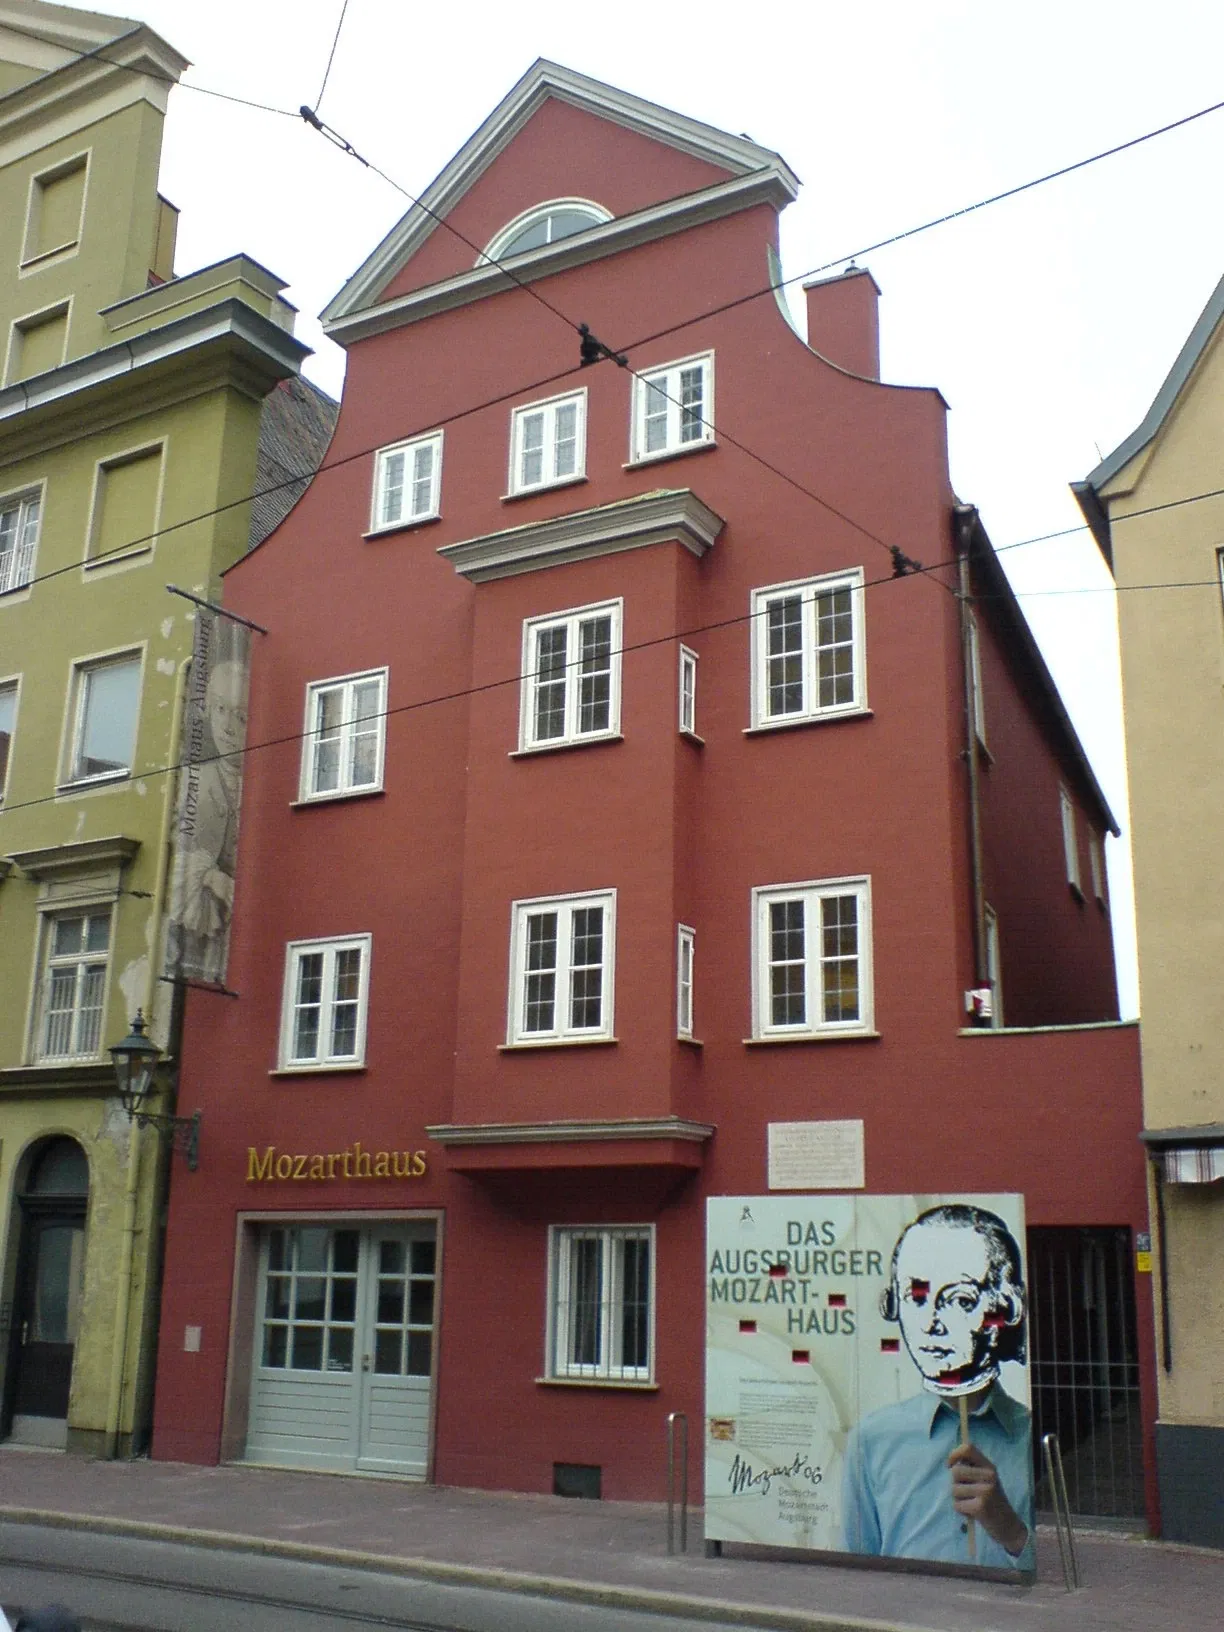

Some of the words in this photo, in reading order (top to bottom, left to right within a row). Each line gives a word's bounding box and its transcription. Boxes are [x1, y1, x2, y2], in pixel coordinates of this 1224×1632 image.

[190, 615, 213, 712] Augsburg
[246, 1142, 427, 1181] Mozarthaus
[787, 1220, 836, 1246] DAS
[709, 1249, 884, 1276] AUGSBURGER
[711, 1277, 819, 1305] MOZART-
[788, 1308, 856, 1335] HAUS
